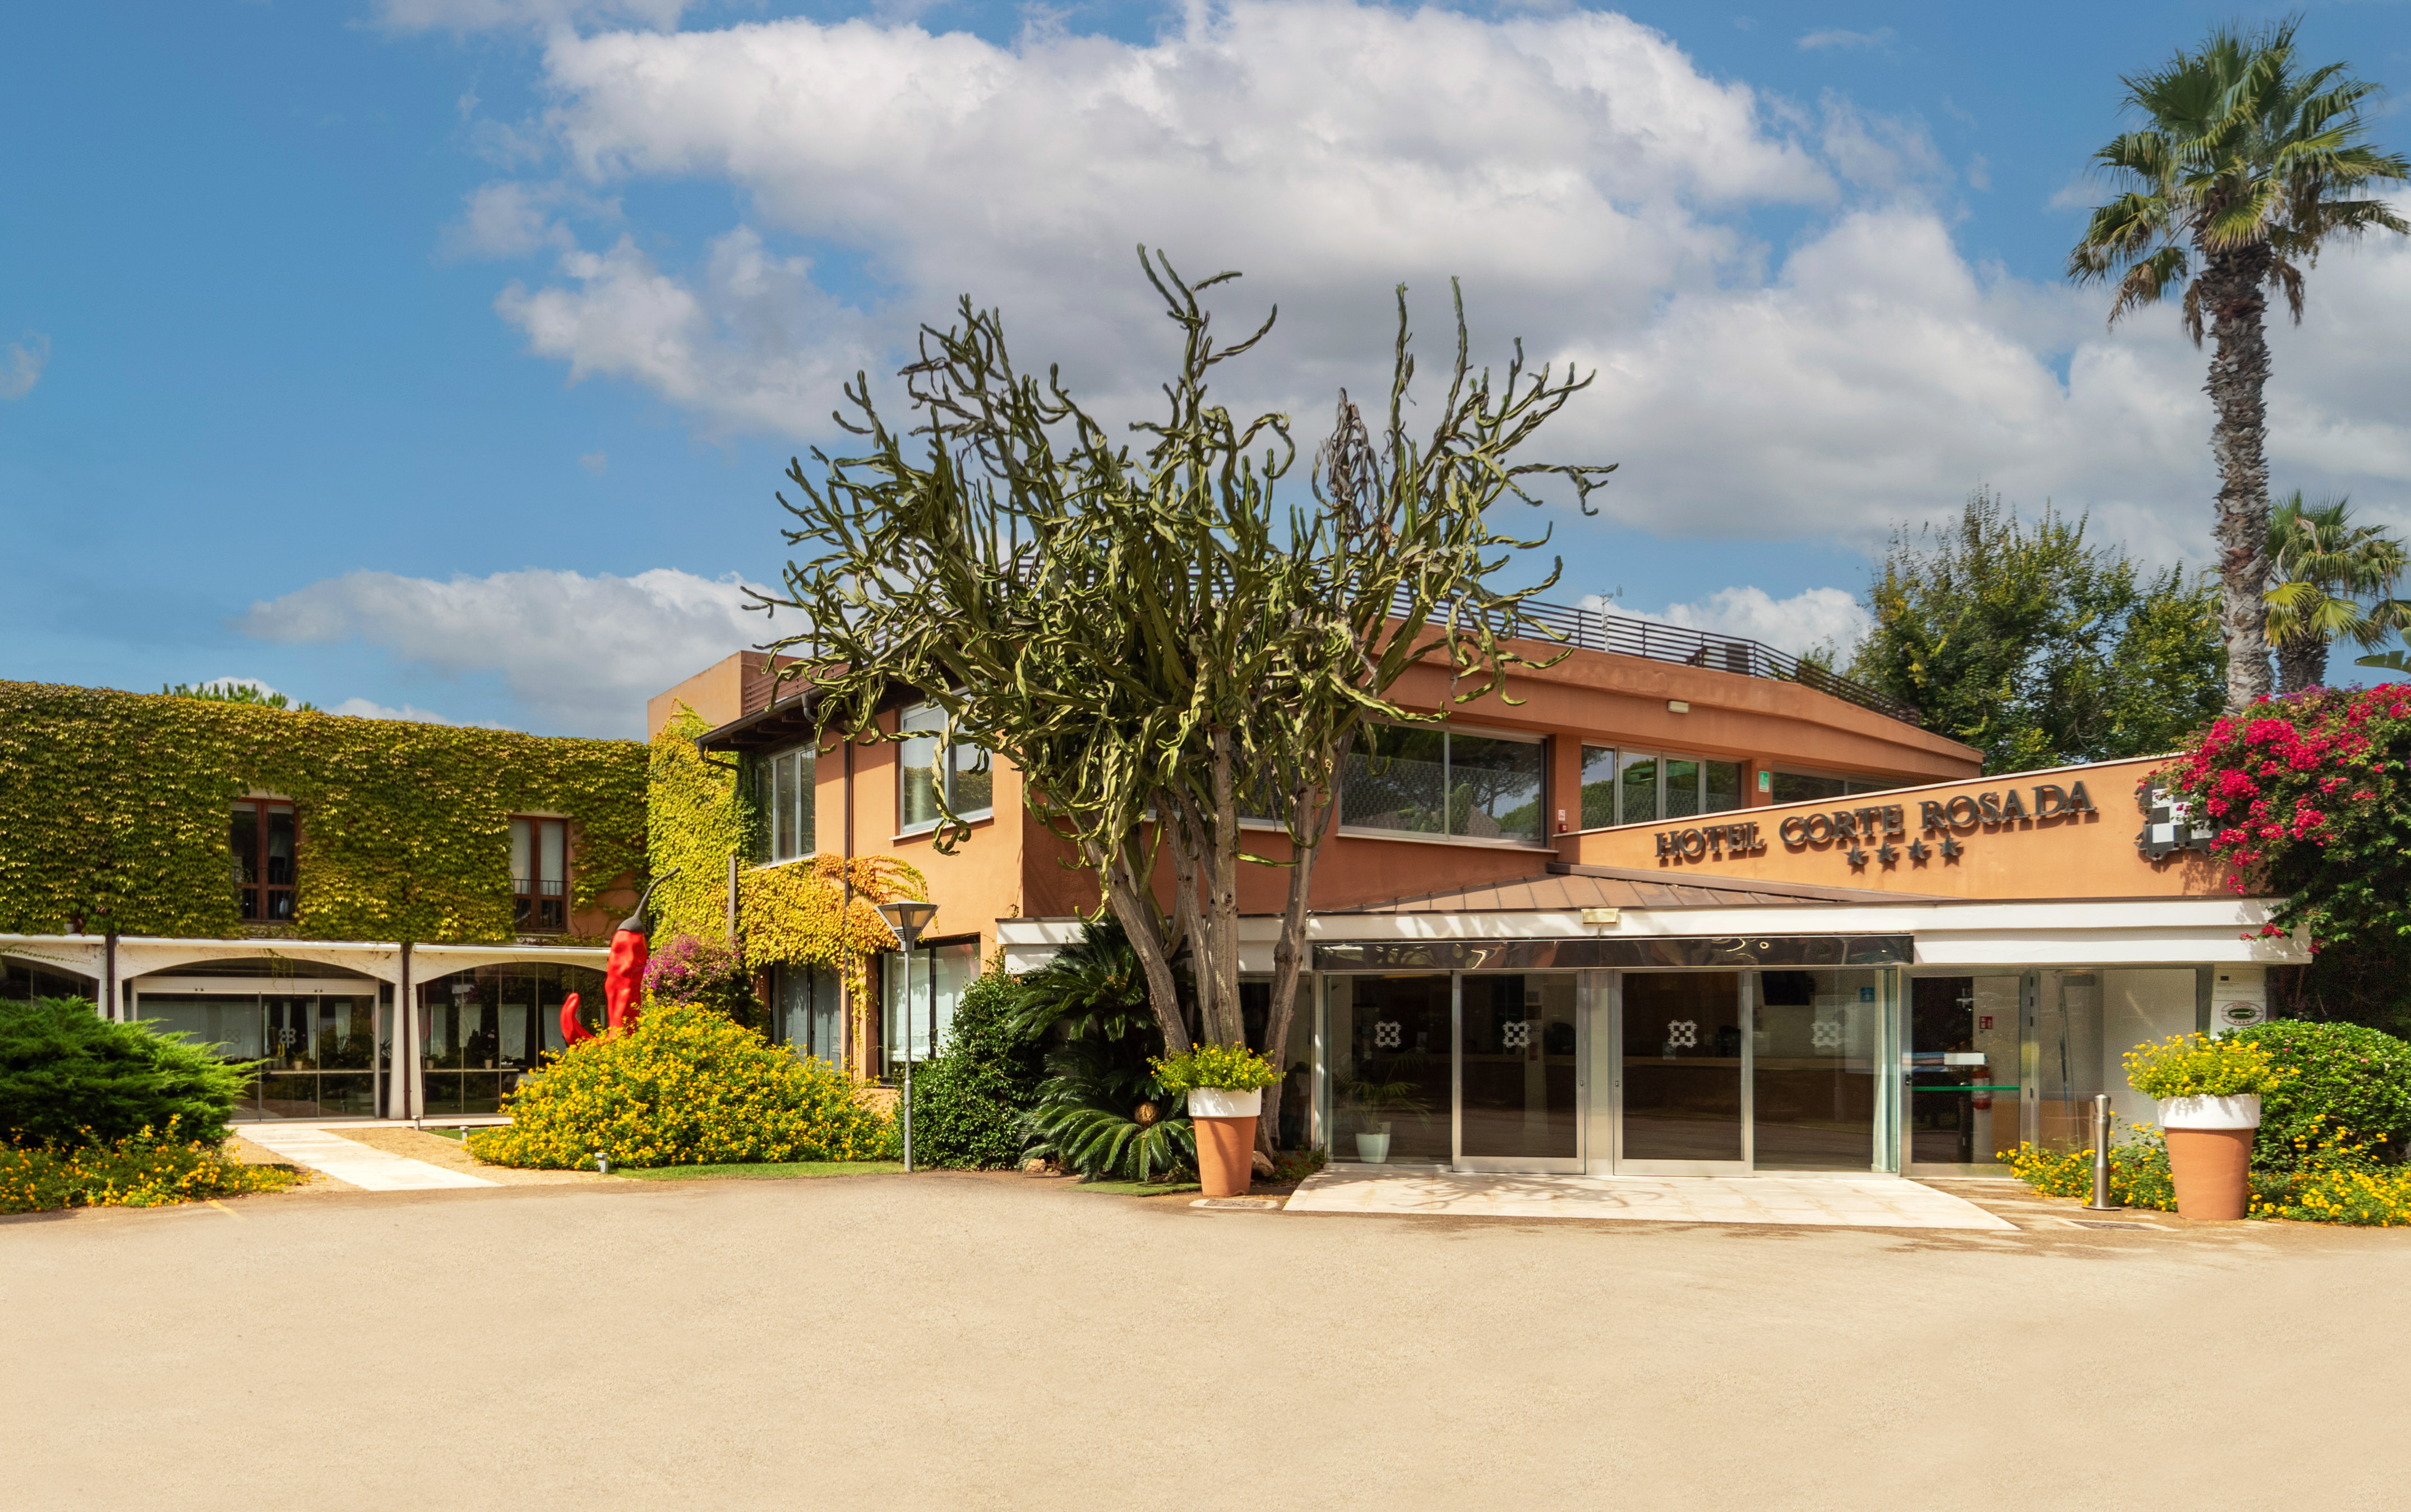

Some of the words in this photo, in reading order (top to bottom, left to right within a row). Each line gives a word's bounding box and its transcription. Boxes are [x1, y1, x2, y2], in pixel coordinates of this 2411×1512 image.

[1654, 821, 1765, 857] HOTEL
[1780, 804, 1903, 844] CORTE
[1918, 780, 2097, 829] ROSADA
